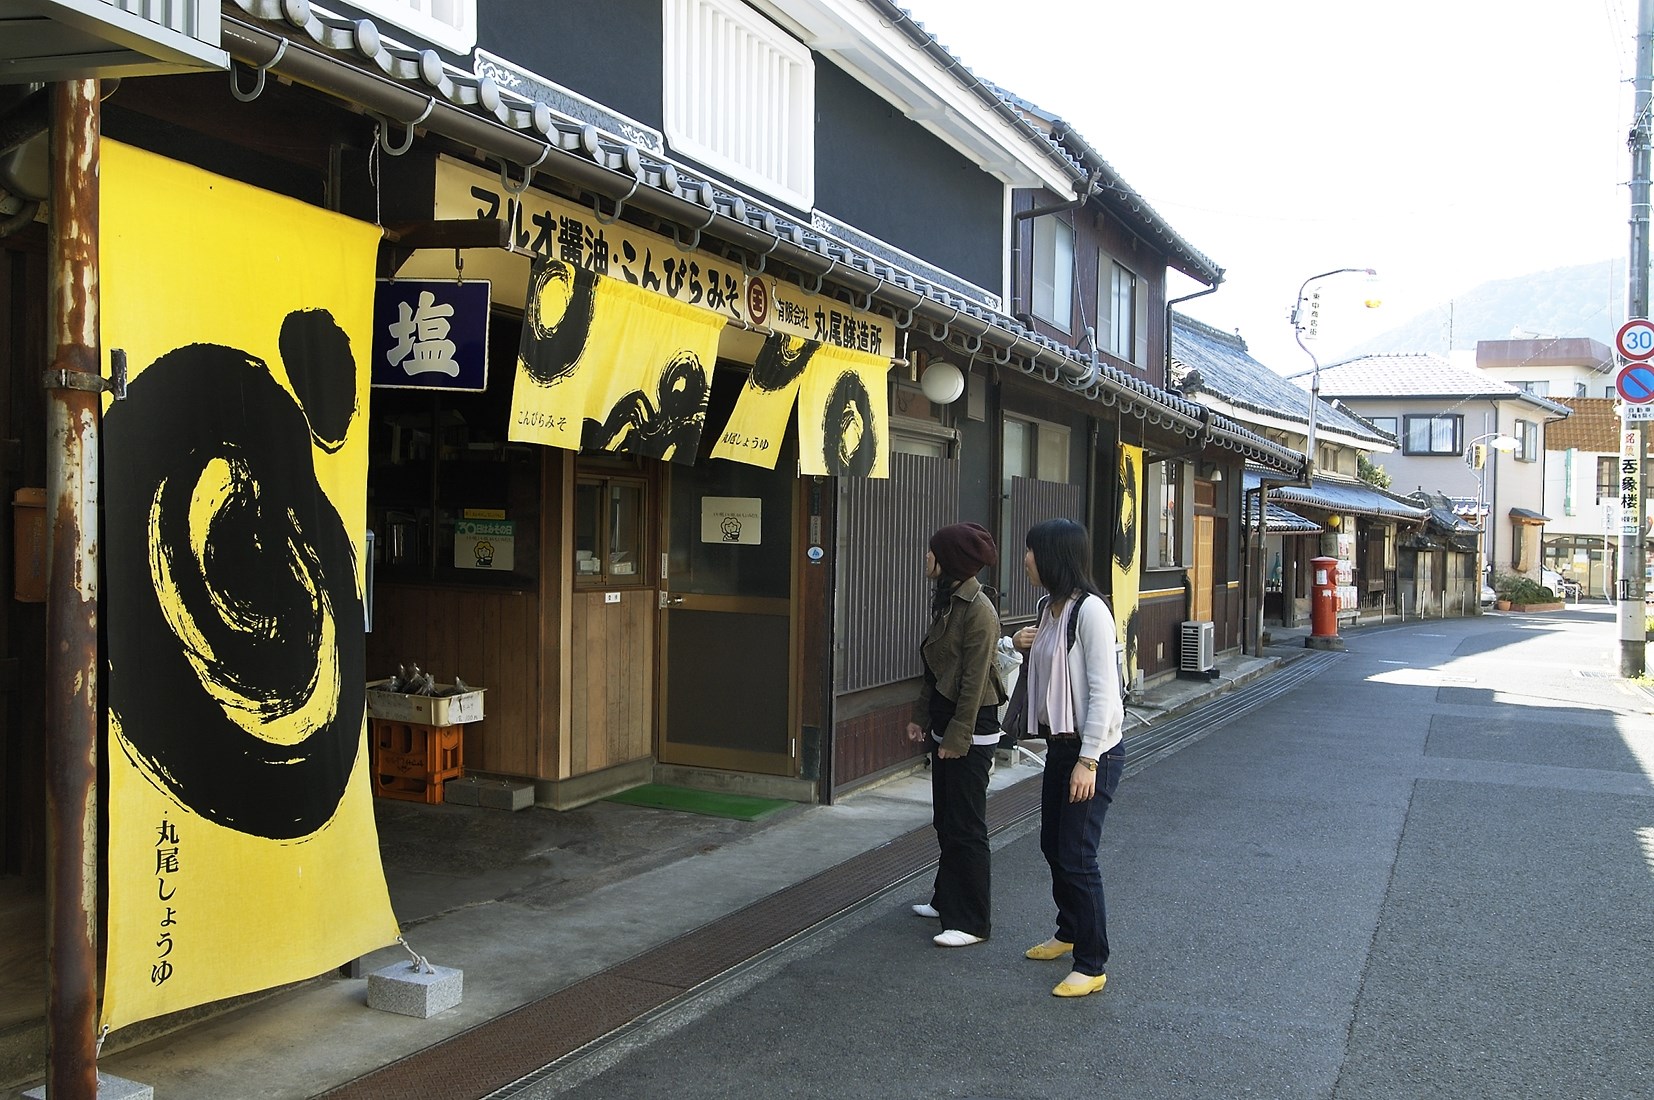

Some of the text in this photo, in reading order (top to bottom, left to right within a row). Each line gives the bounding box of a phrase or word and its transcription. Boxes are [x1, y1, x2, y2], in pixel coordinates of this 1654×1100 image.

[387, 291, 460, 377] 塩
[777, 298, 810, 330] 有限会社
[1626, 331, 1652, 350] 30
[151, 820, 180, 987] 丸尾しょうゆ
